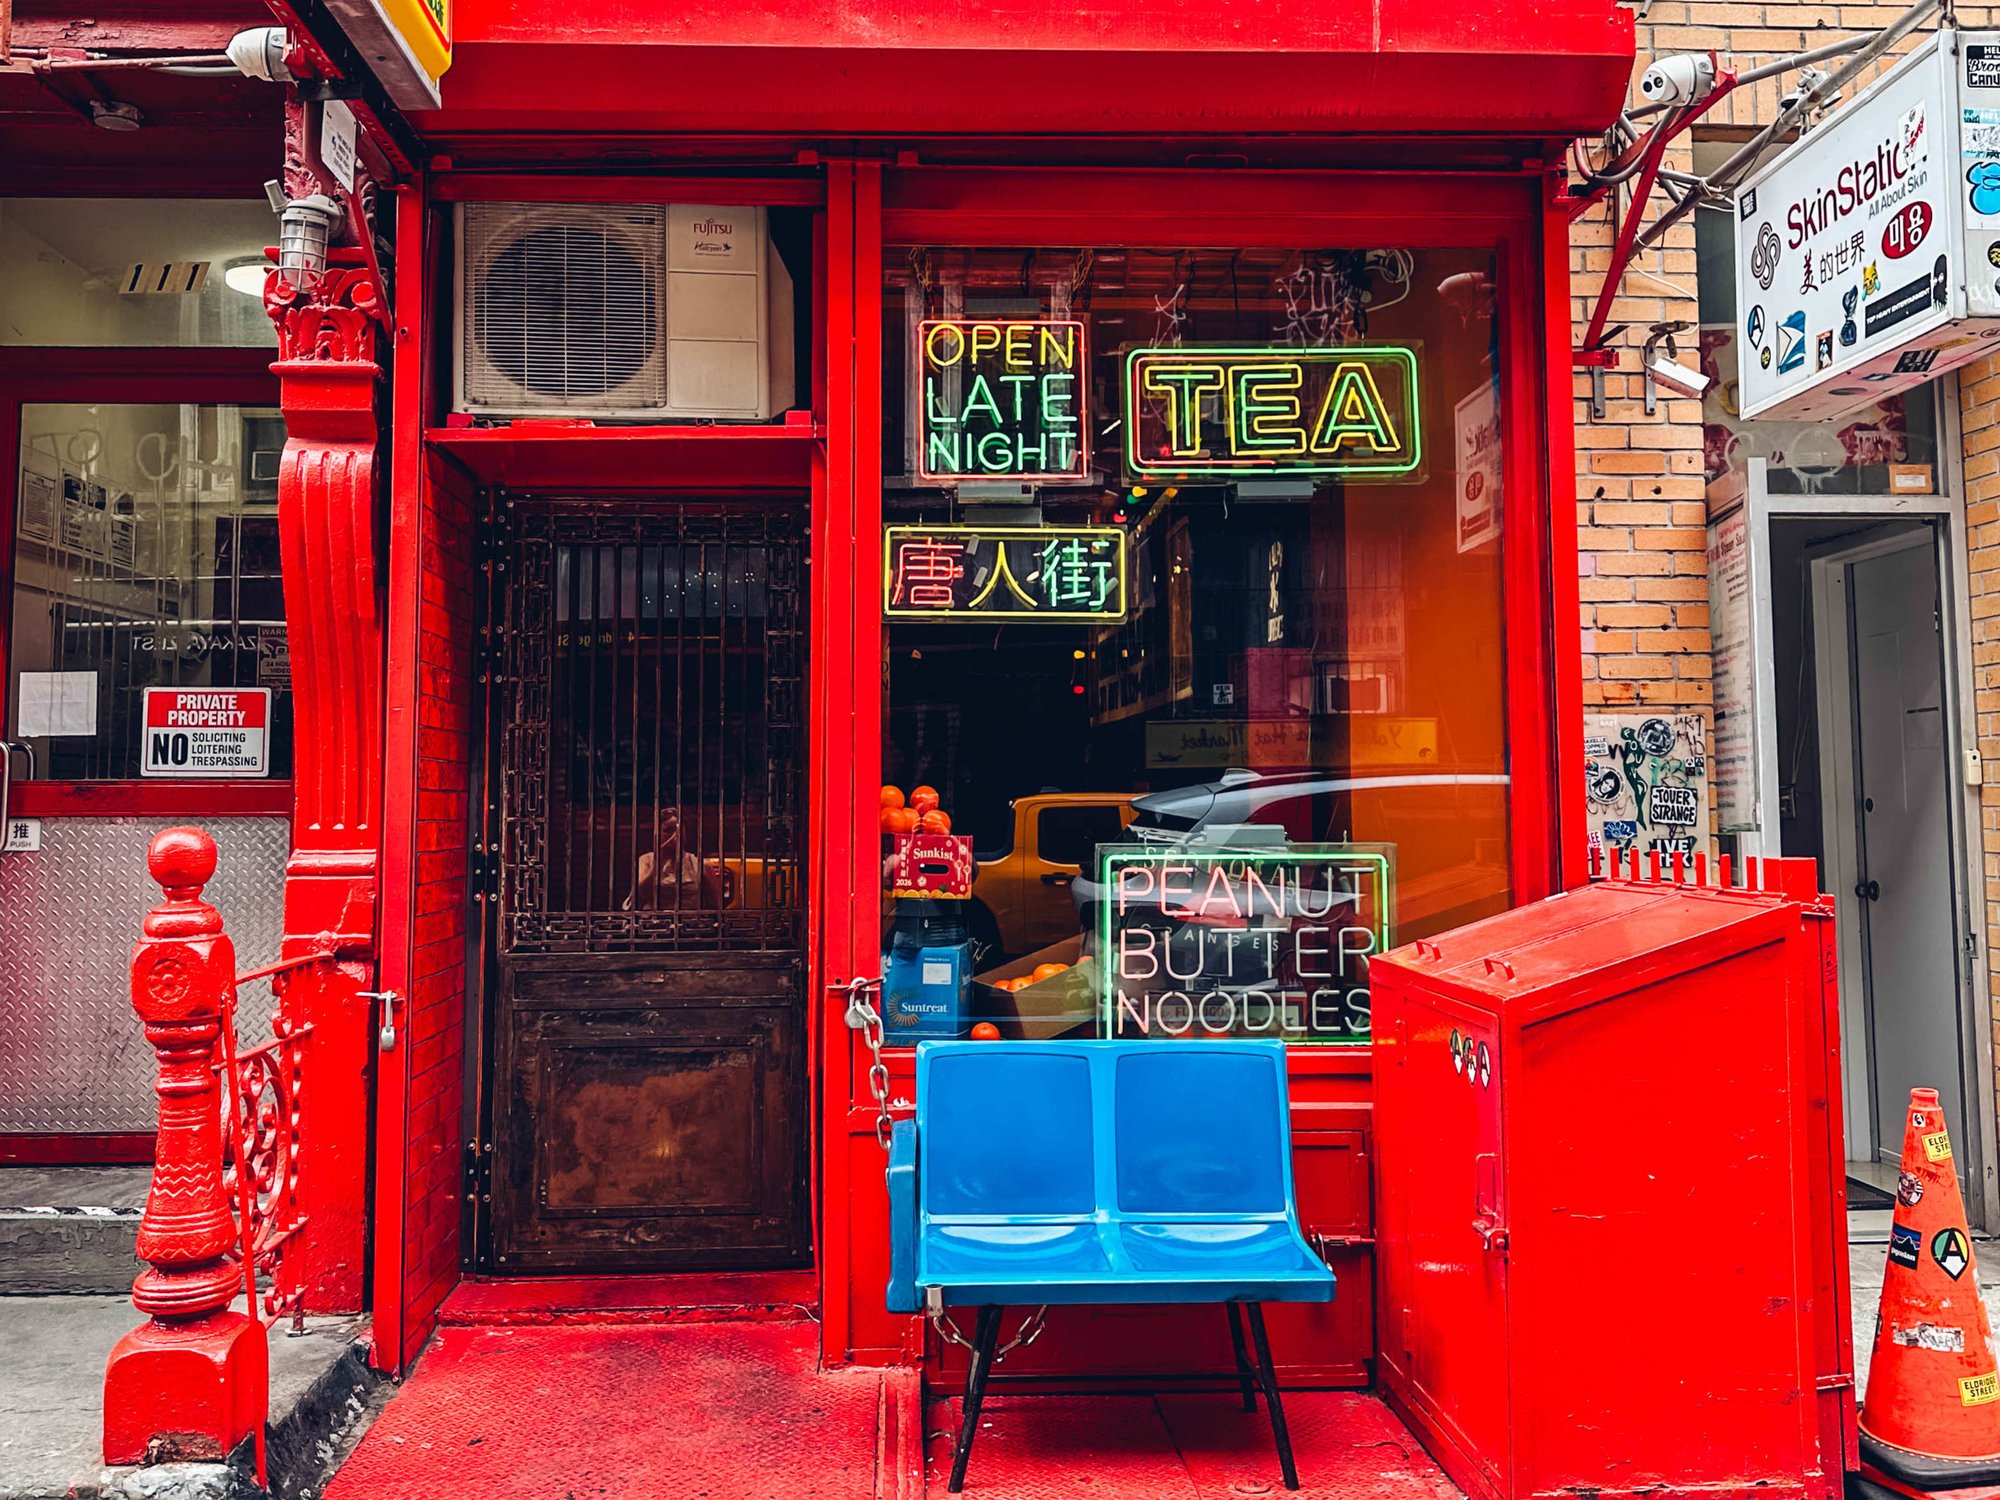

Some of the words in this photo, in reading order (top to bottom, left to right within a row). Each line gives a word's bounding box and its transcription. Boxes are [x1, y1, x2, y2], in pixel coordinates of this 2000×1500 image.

[1868, 199, 1880, 220] All
[1880, 183, 1906, 212] About
[1907, 170, 1928, 193] Skin
[693, 220, 732, 236] FUJITSU
[1888, 204, 1925, 252] 미용
[1800, 230, 1865, 295] 美的世界
[926, 324, 1074, 369] OPEN
[927, 374, 1077, 424] LATE
[1144, 363, 1402, 457] TEA
[929, 431, 1077, 473] NIGHT
[892, 537, 1112, 608] 唐人街
[176, 694, 238, 710] PRIVATE
[167, 710, 246, 726] PROPERTY
[191, 732, 246, 743] SOLICITING
[152, 732, 189, 766] NO
[191, 744, 242, 755] LOITERING
[191, 756, 258, 767] TRESPASSING
[1652, 804, 1696, 823] STRANGE
[13, 823, 29, 839] 推
[913, 847, 954, 861] Sunkist
[896, 878, 912, 887] 2026
[1118, 867, 1375, 919] PEANUT
[1119, 928, 1376, 980] BUTTER
[901, 1002, 947, 1013] Suntreat
[1117, 990, 1372, 1035] NOODLES
[1964, 1376, 1997, 1390] ELDRIDGE
[1970, 1385, 1996, 1397] STREET
